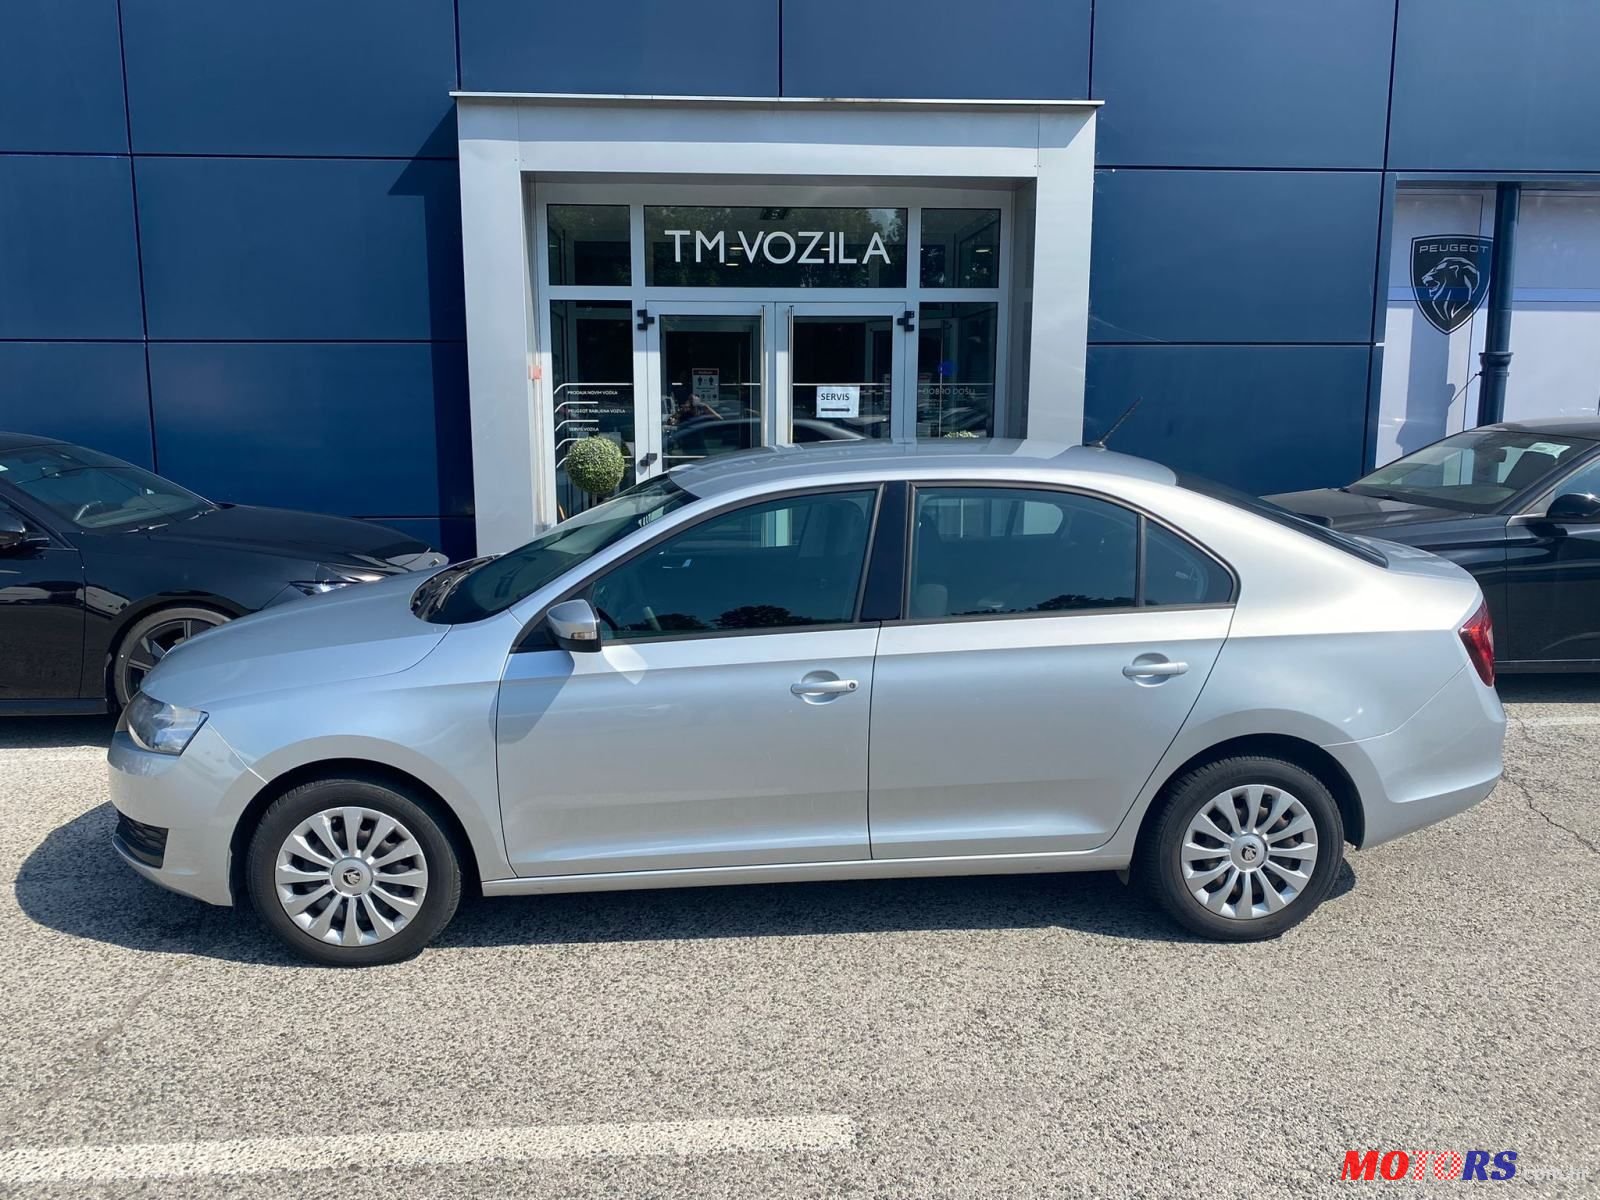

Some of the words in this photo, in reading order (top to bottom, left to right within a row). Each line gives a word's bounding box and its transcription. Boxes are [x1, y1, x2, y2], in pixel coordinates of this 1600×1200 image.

[664, 229, 724, 263] TM
[737, 230, 892, 265] VOZILA
[1419, 243, 1489, 254] PEUGEOT
[820, 392, 850, 401] SERVIS
